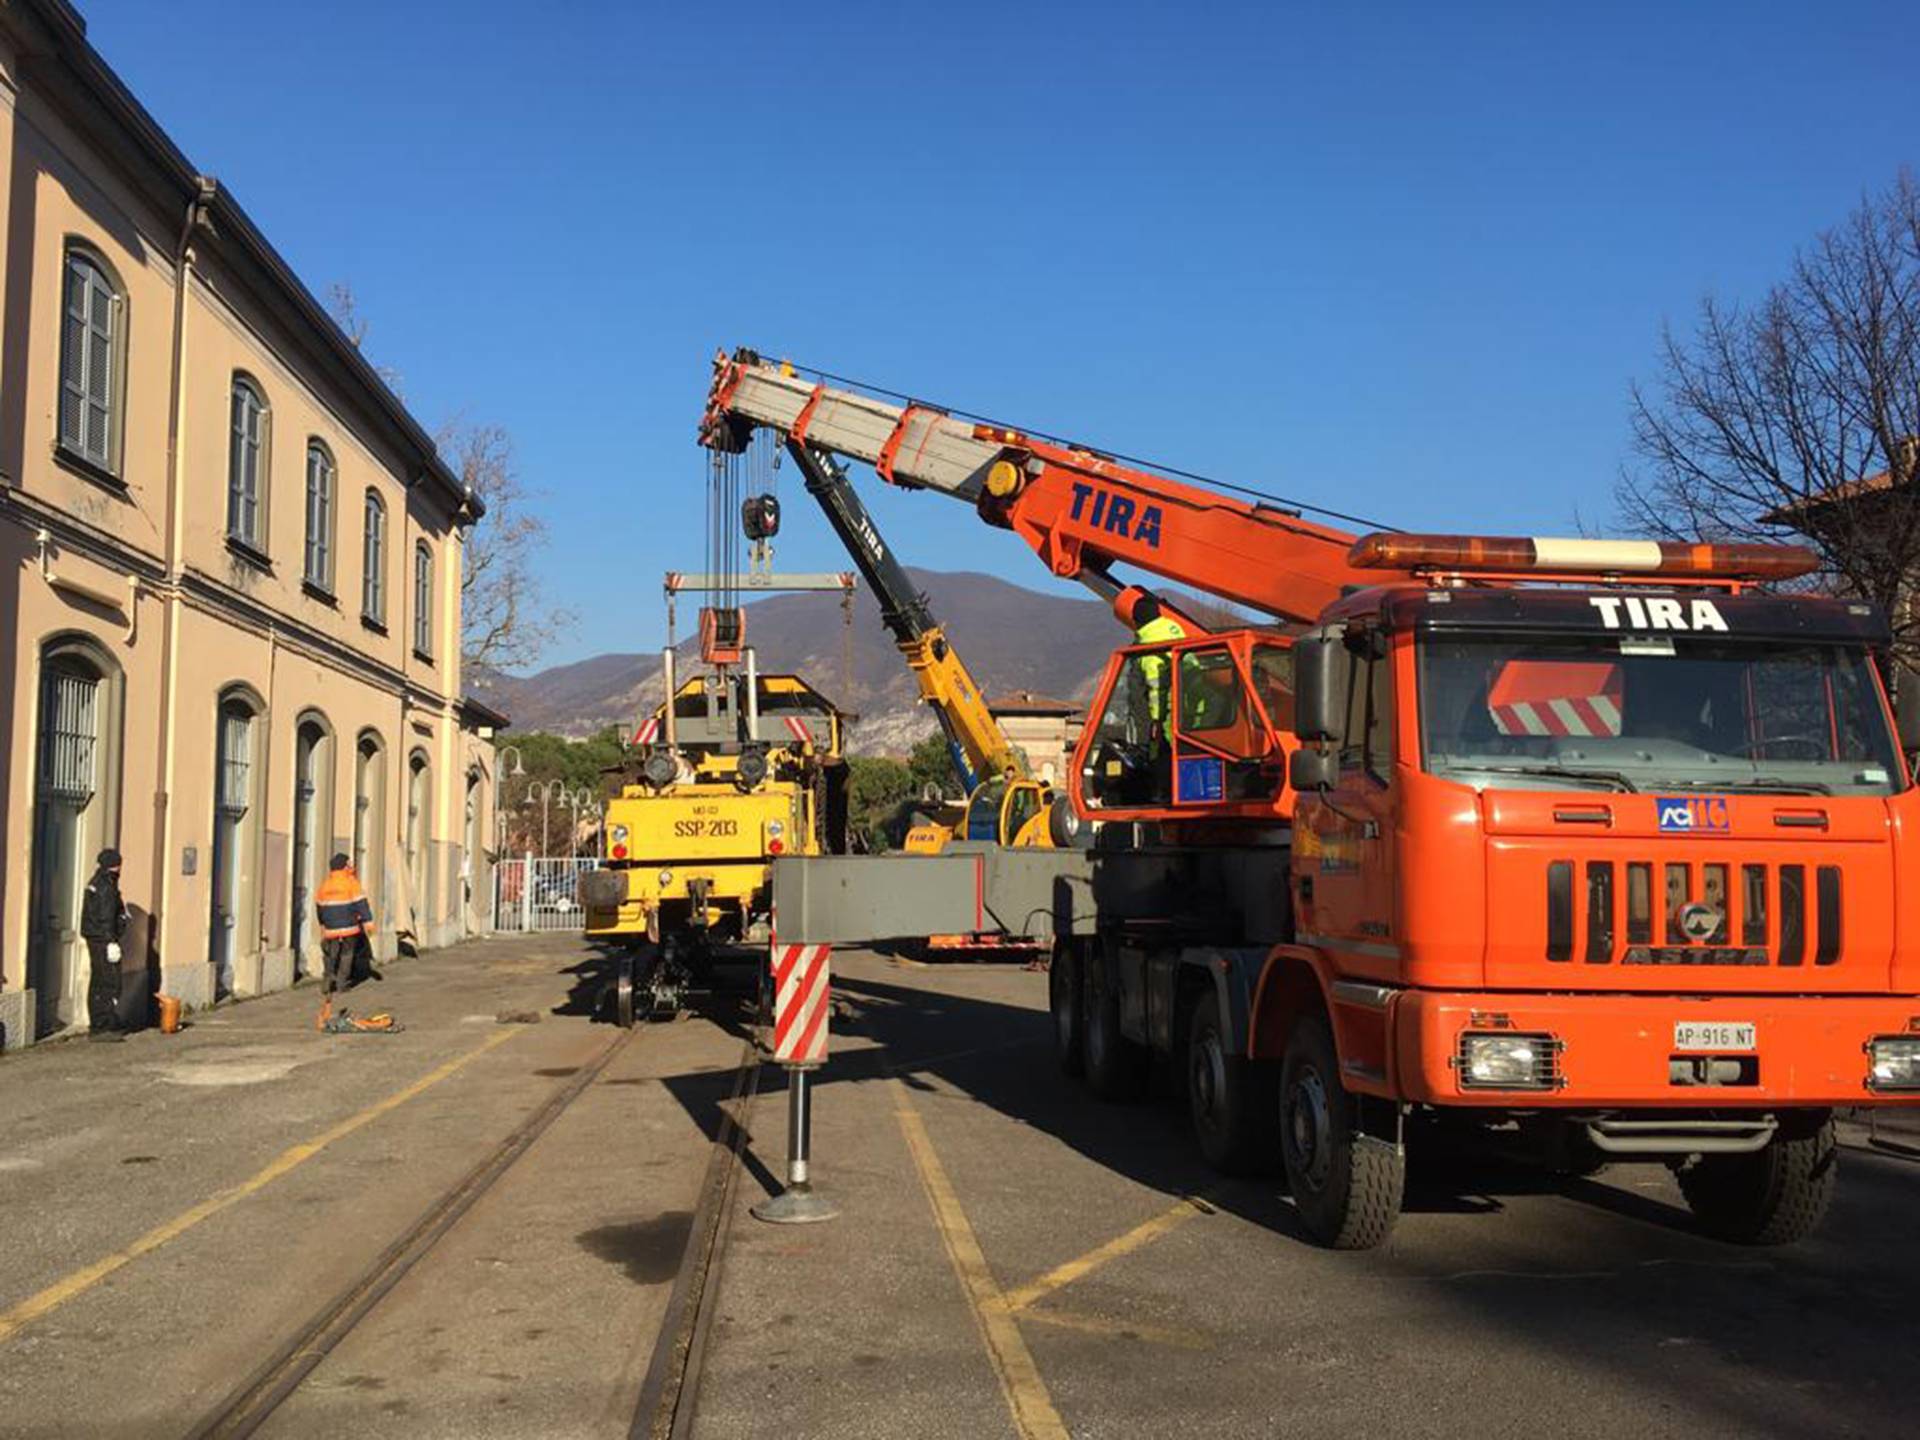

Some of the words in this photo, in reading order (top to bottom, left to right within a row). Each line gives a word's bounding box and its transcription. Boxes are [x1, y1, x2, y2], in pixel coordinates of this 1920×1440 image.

[1070, 482, 1162, 549] TIRA
[1588, 597, 1730, 631] TIRA
[1677, 1028, 1694, 1044] AP
[1702, 1028, 1730, 1045] 916
[1736, 1028, 1753, 1045] NT
